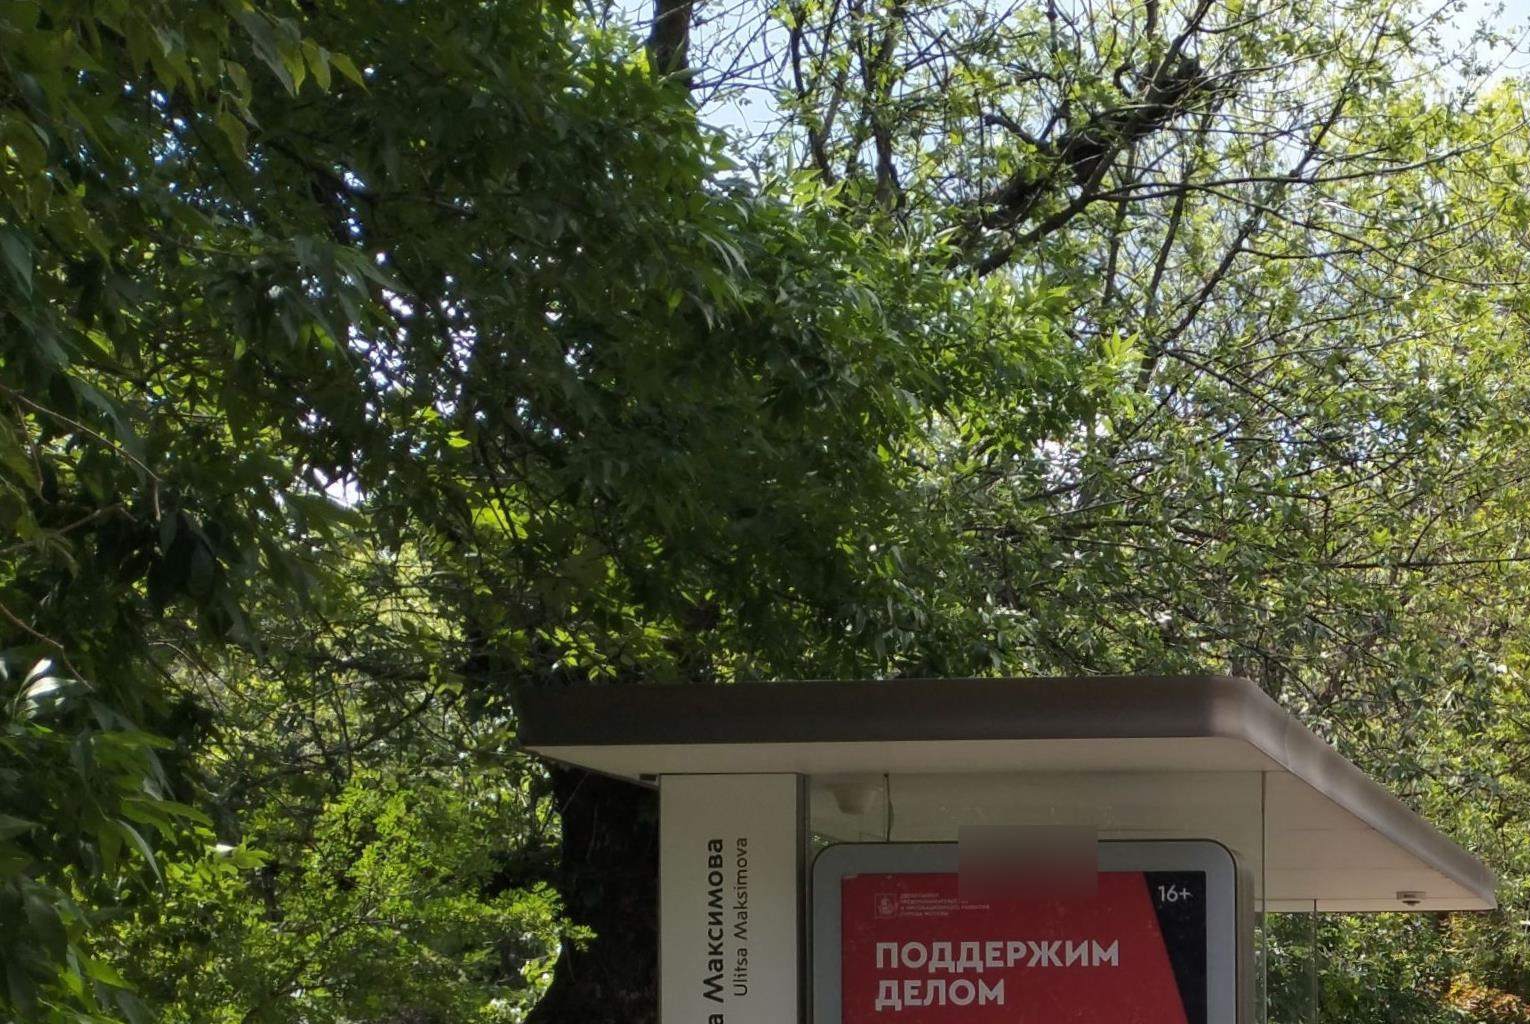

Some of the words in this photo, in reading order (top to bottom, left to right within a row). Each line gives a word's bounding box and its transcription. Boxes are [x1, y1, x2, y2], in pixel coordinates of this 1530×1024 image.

[733, 837, 748, 941] Maksimova
[1158, 884, 1191, 902] 16+
[702, 838, 725, 1003] Максимова
[733, 947, 748, 997] Ulitsa
[875, 939, 1120, 974] ПОДДЕРЖИМ
[874, 978, 1006, 1012] ДЕЛОМ
